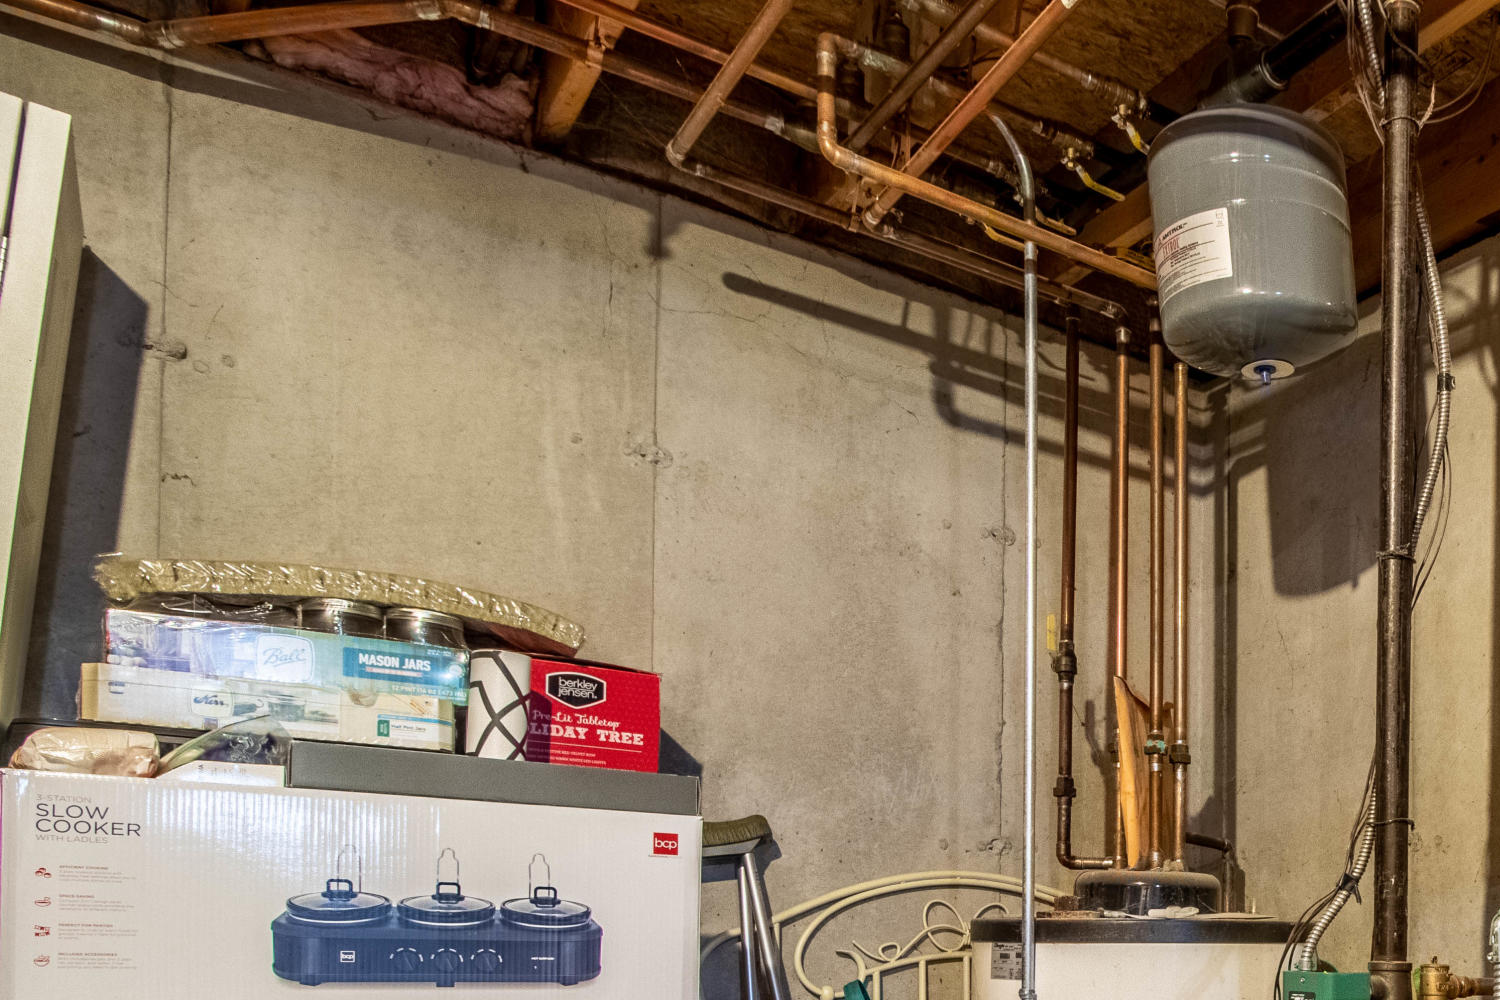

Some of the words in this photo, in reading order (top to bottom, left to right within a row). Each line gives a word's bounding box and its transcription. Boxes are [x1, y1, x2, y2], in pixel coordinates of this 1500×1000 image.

[358, 653, 400, 668] MASON
[402, 658, 431, 672] JARS
[558, 676, 598, 691] berkley
[532, 709, 573, 723] Pre-Lit
[574, 713, 621, 732] Tabletop
[597, 729, 645, 746] TREE
[36, 803, 109, 820] SLOW
[35, 818, 142, 837] COOKER
[35, 834, 64, 842] WITH
[66, 836, 109, 844] LADLES
[654, 837, 678, 849] bcp
